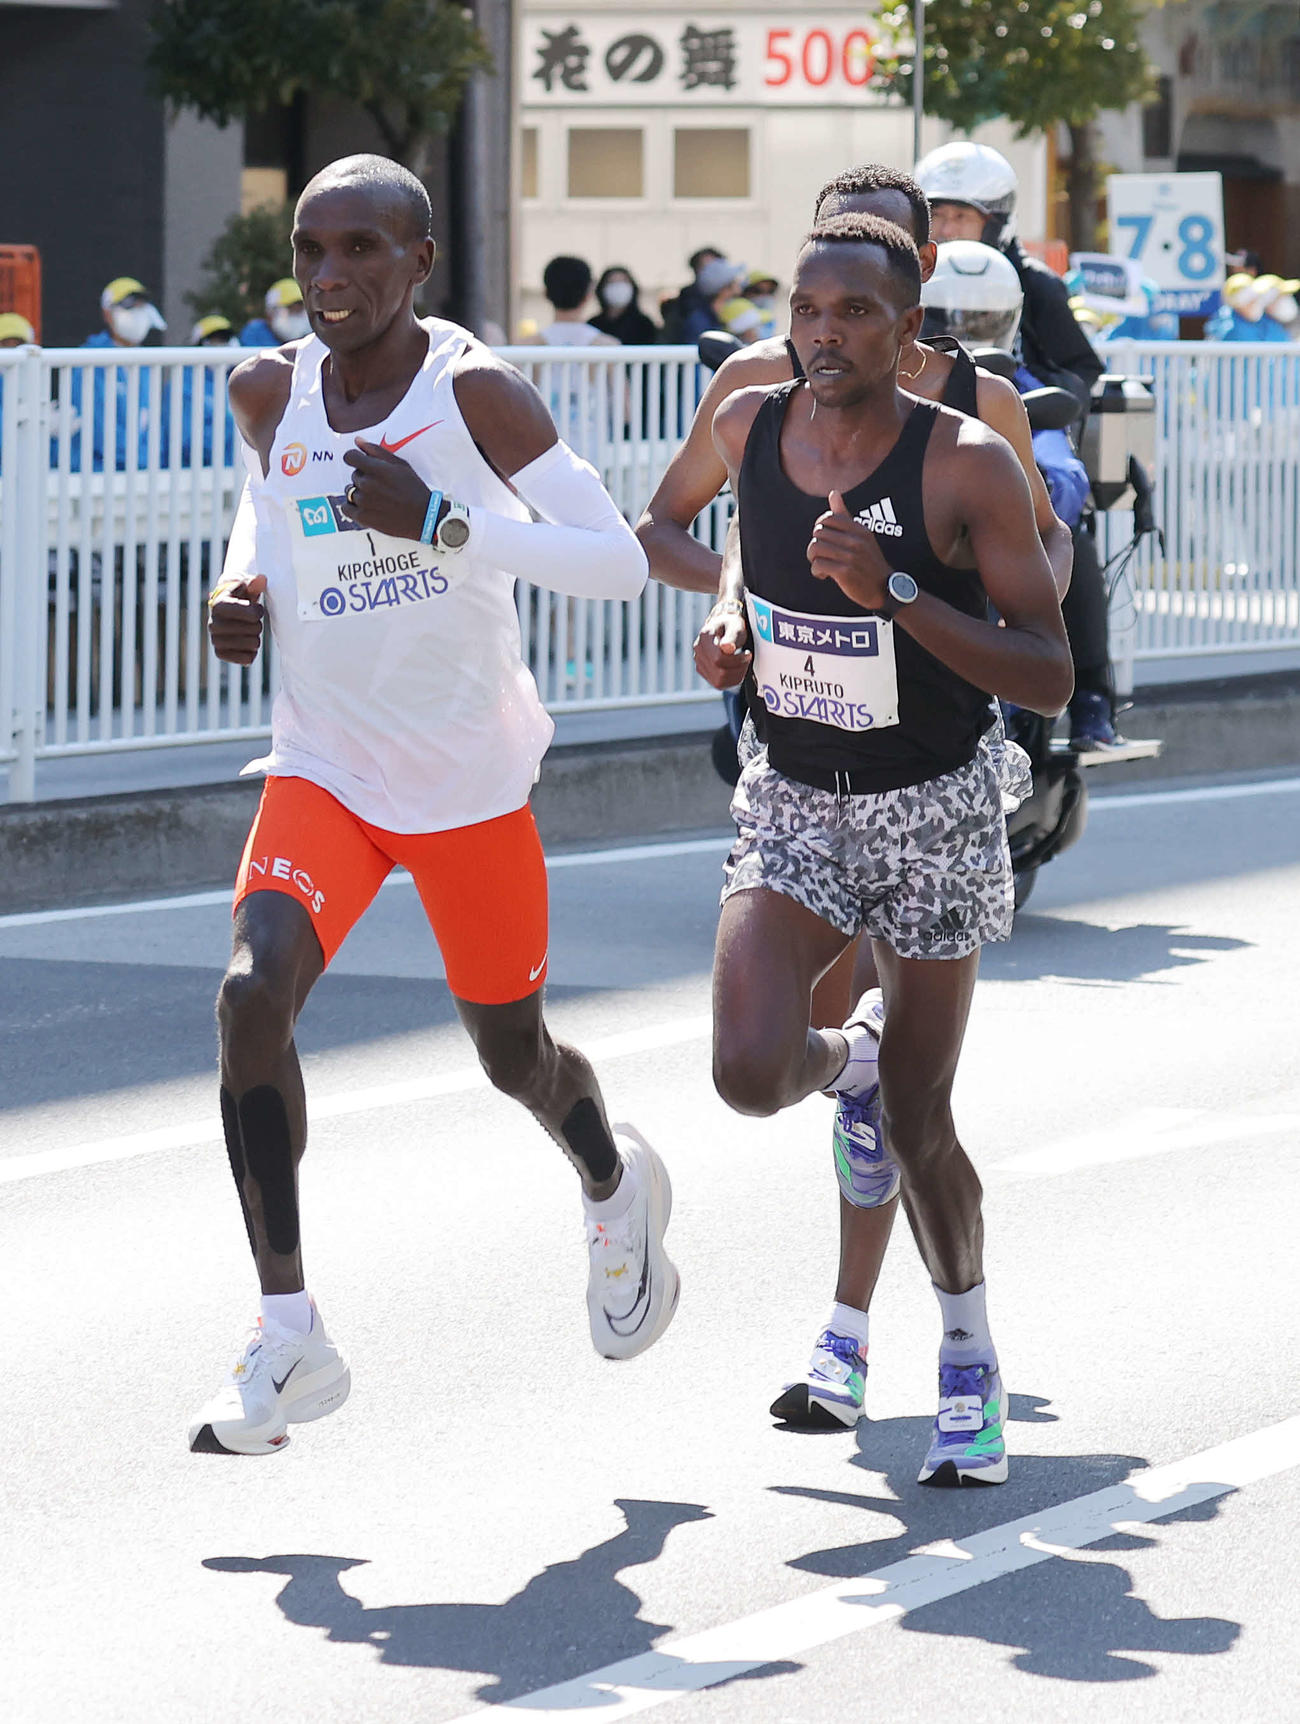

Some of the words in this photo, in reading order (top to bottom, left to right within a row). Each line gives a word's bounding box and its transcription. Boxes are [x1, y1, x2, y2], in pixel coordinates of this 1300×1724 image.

[532, 24, 737, 92] 花の舞
[764, 28, 875, 86] 500
[311, 450, 334, 462] NN
[337, 551, 421, 582] KIPCHOGE
[777, 621, 871, 649] 東京メトロ
[803, 654, 816, 677] 4
[779, 672, 844, 699] KIPRUTO
